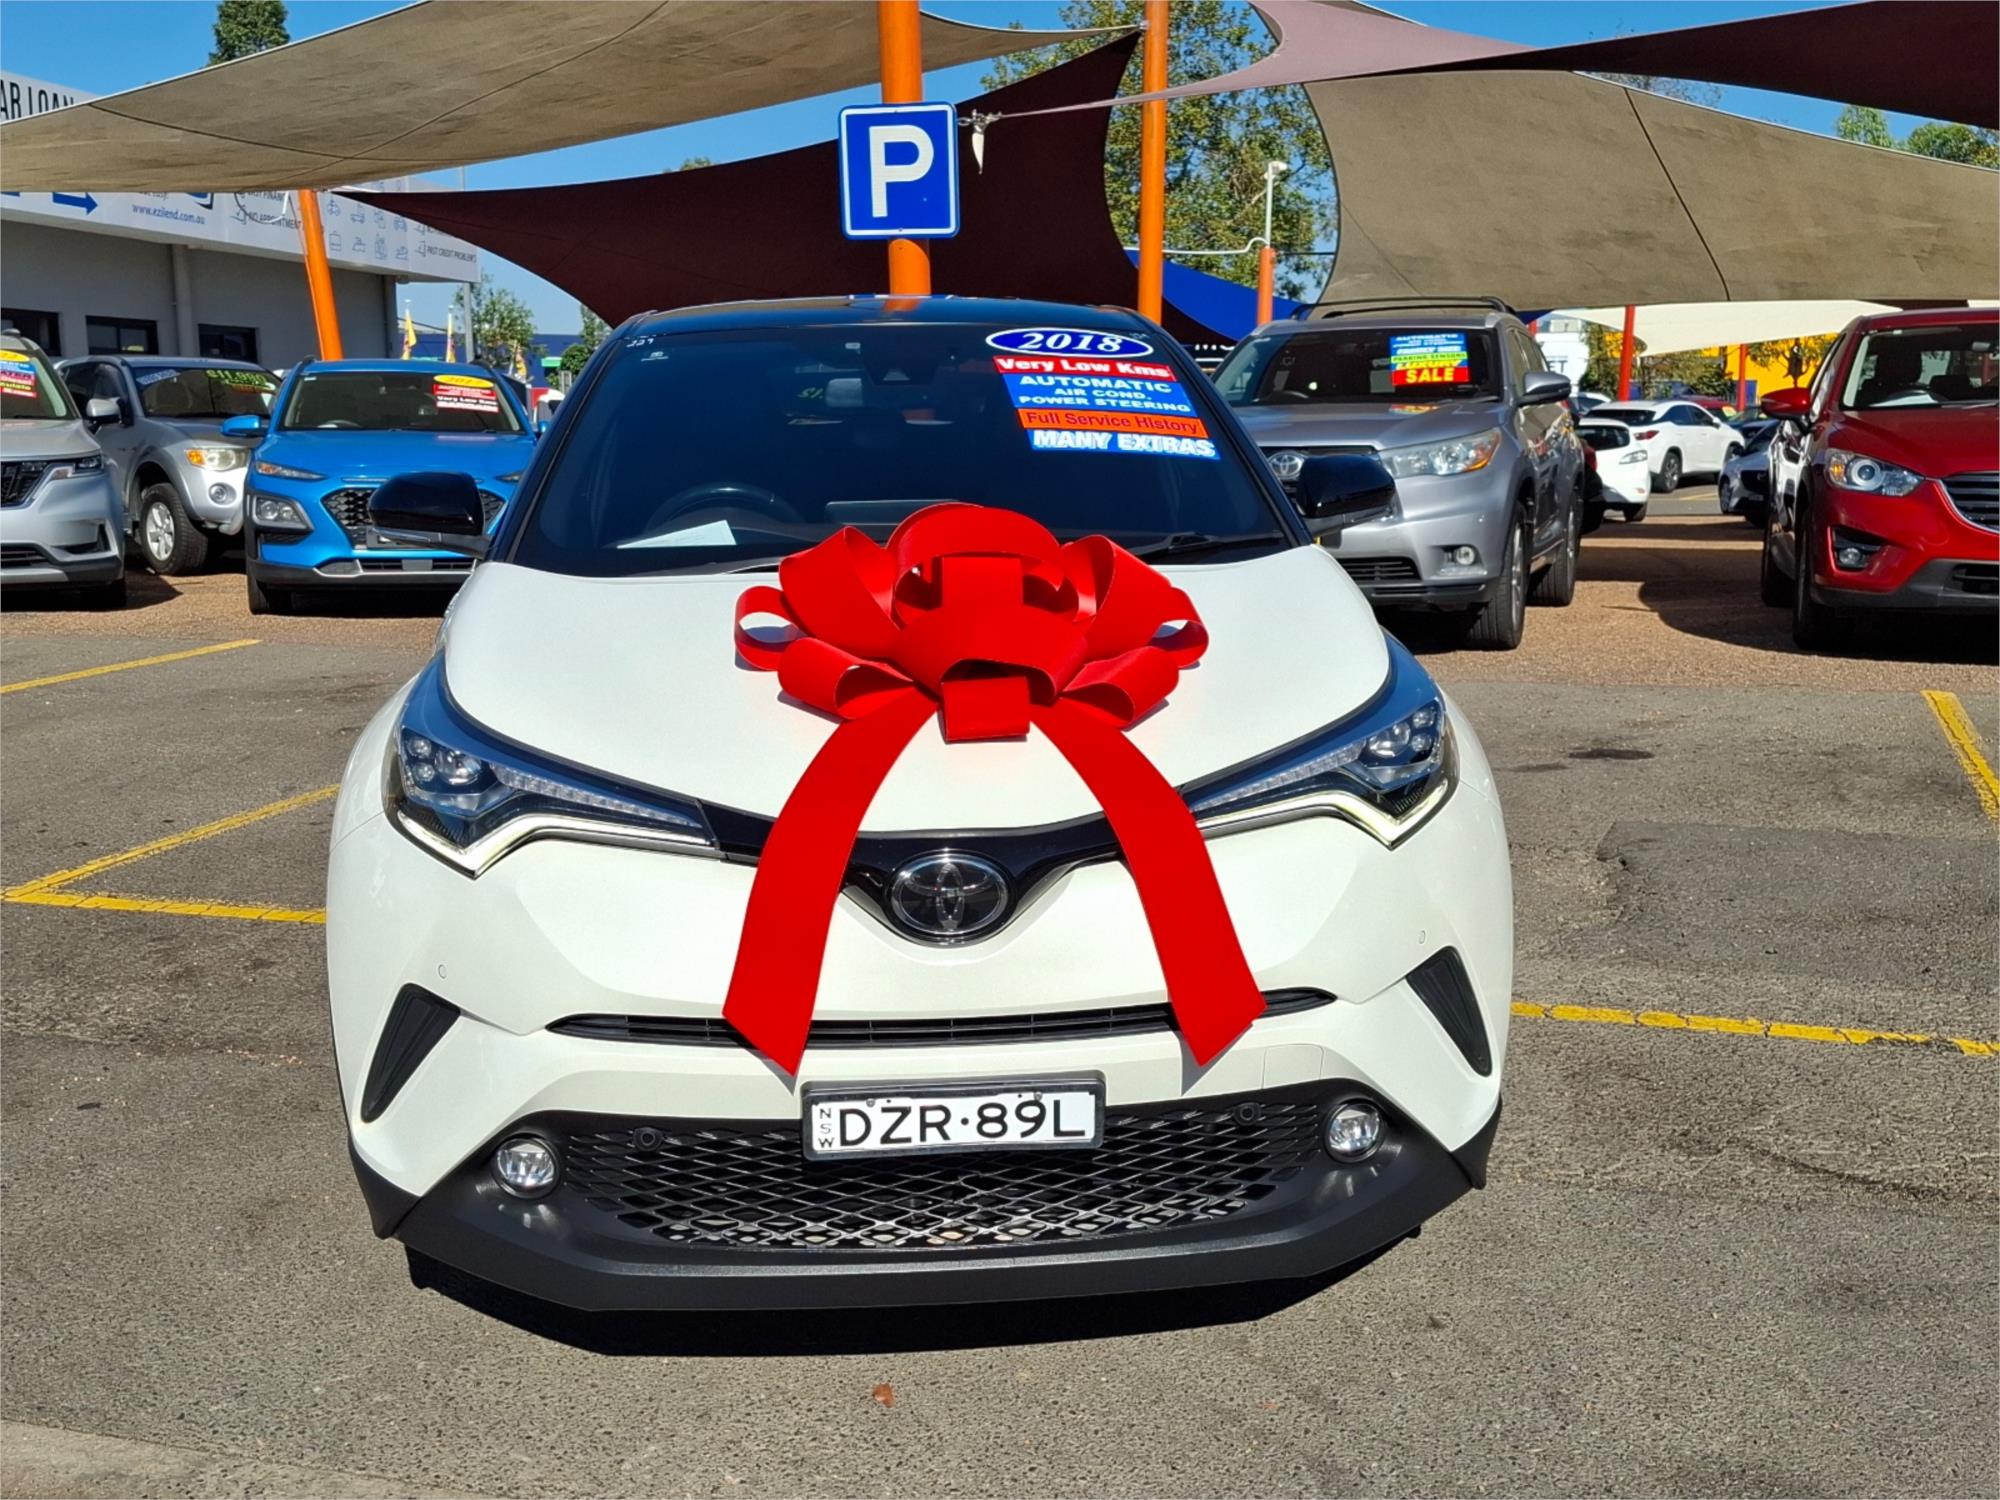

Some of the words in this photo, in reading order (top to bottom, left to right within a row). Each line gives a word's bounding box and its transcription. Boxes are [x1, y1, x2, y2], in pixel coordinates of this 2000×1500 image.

[28, 86, 74, 115] LO
[868, 124, 935, 218] P
[1016, 332, 1124, 352] 2018
[997, 358, 1053, 372] Very
[1061, 360, 1112, 373] Low
[1116, 362, 1170, 378] Kms
[1405, 367, 1455, 384] SALE
[1019, 375, 1172, 393] AUTOMATIC
[1054, 387, 1087, 397] AIR
[1092, 389, 1152, 400] COND.
[1019, 395, 1090, 406] POWER
[1101, 398, 1191, 413] STEERING
[1027, 411, 1061, 424] Full
[1065, 413, 1130, 427] Service
[1033, 430, 1112, 450] MANY
[1117, 433, 1216, 457] EXTRAS
